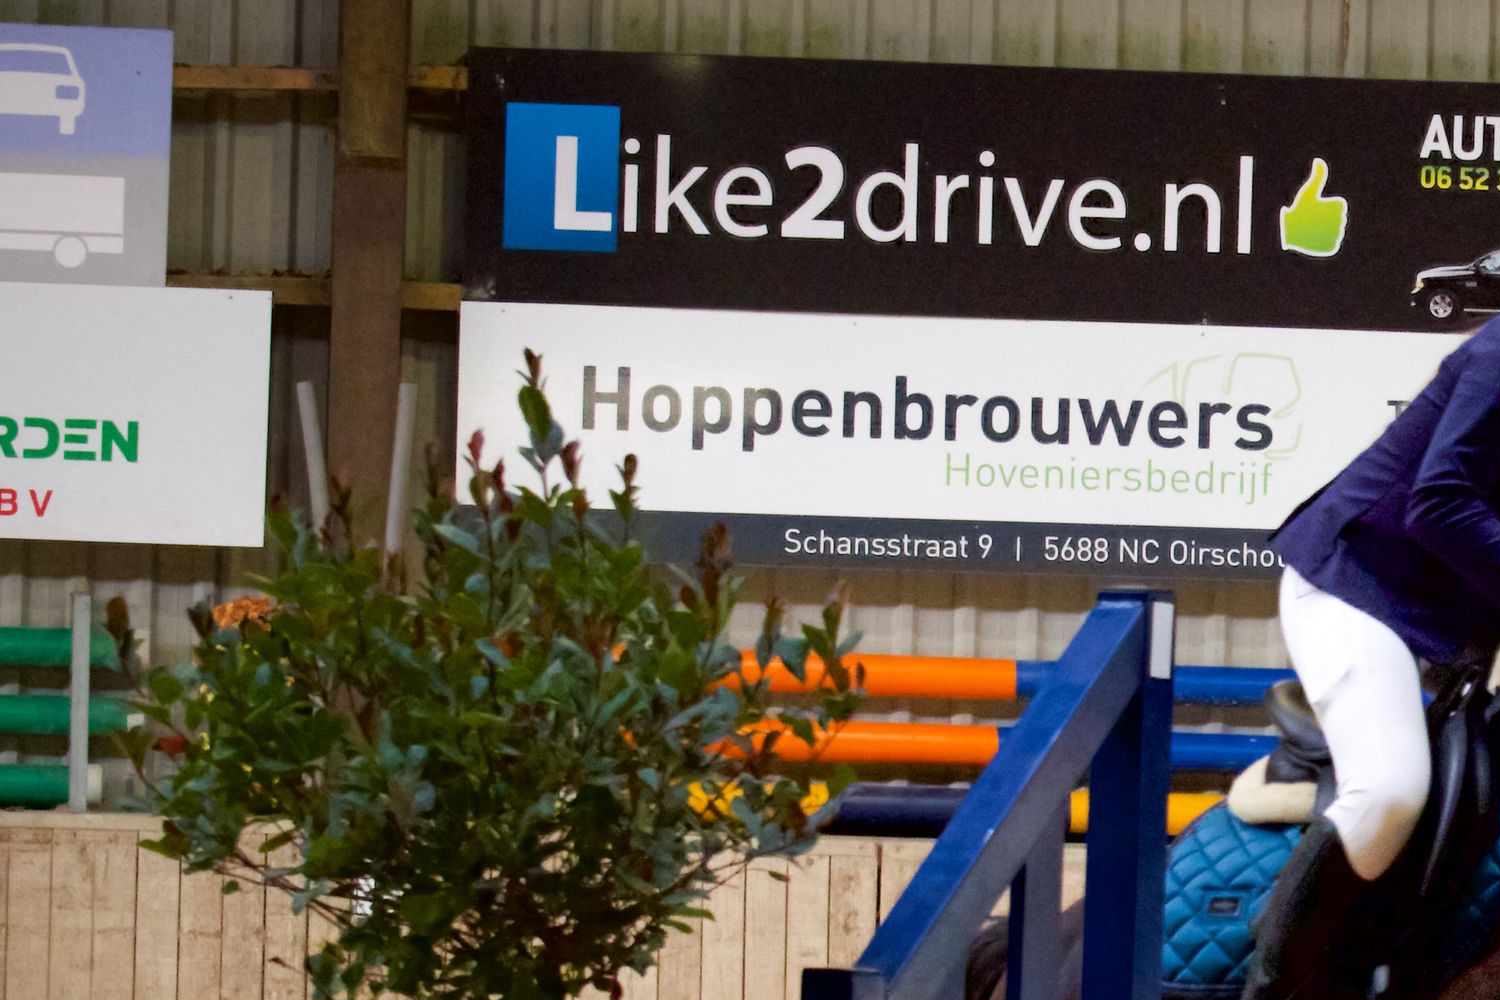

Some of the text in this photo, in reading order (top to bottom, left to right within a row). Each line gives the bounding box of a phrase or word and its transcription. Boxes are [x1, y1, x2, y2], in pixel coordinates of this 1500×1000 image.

[553, 134, 1254, 255] Like2drive.nl
[1420, 165, 1452, 189] 06
[1459, 167, 1489, 191] 52
[581, 365, 1274, 452] Hoppenbrouwers
[0, 416, 139, 463] RDEN
[945, 452, 1273, 505] Hoveniersbedrijf
[784, 527, 969, 559] Schansstraat
[977, 533, 993, 559] 9
[1044, 535, 1109, 562] 5688
[1119, 538, 1160, 564] NC
